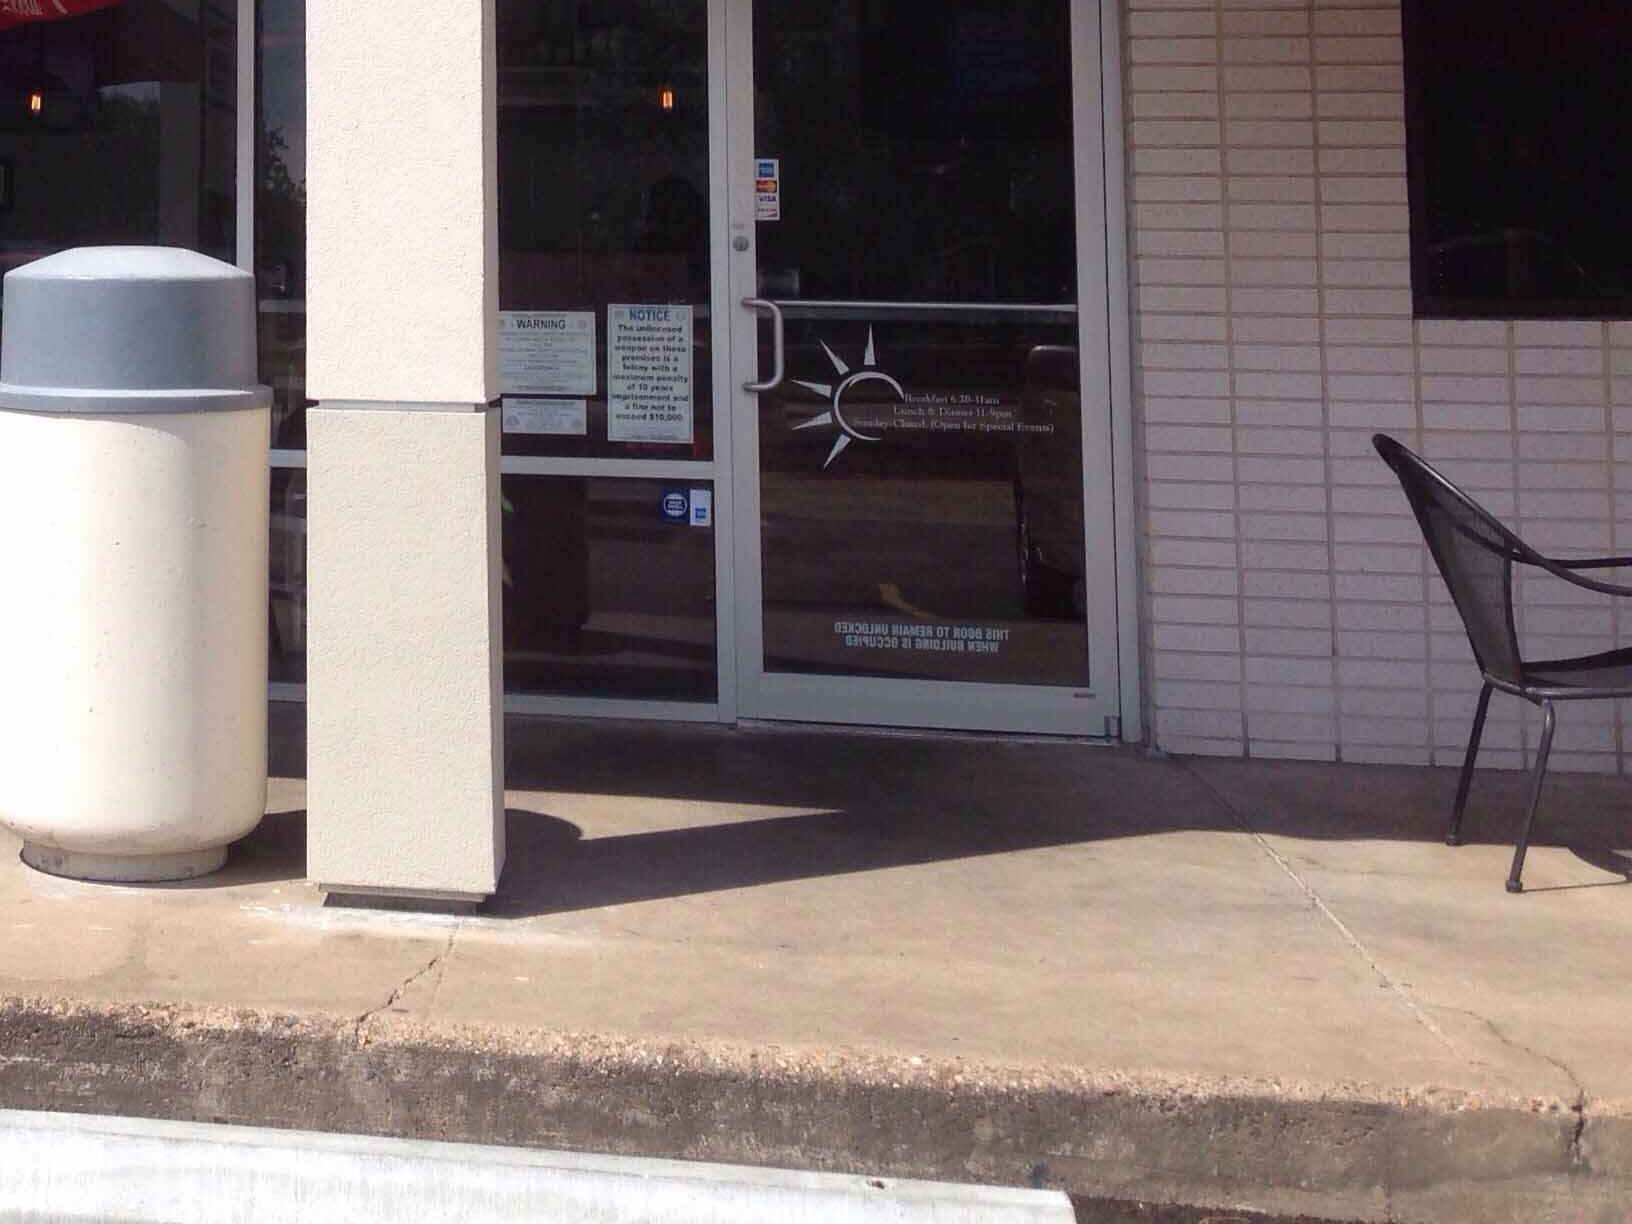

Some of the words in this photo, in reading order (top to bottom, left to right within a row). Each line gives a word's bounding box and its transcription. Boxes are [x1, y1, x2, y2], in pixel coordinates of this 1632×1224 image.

[628, 308, 671, 322] NOTICE
[516, 319, 567, 330] WARNING
[618, 324, 634, 333] The
[667, 334, 677, 343] of
[639, 383, 649, 391] 10
[893, 406, 925, 416] Lunch
